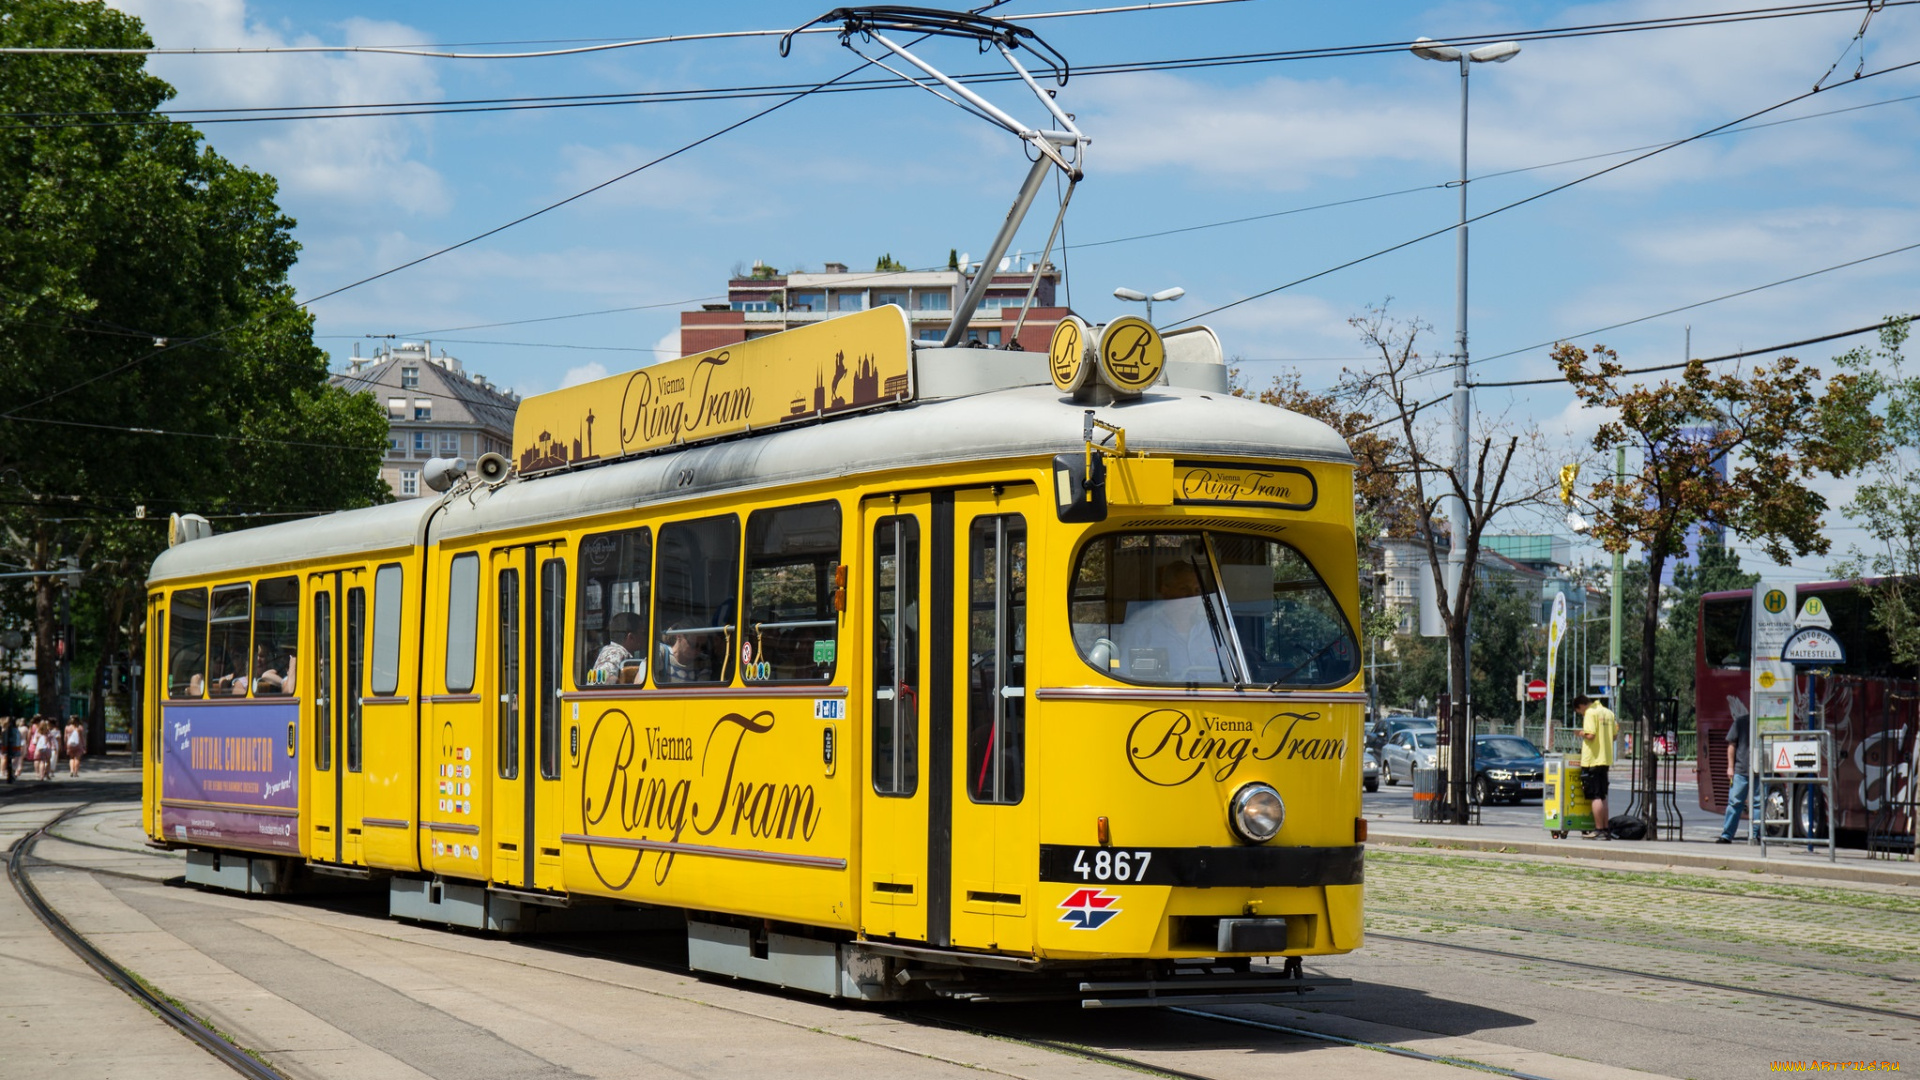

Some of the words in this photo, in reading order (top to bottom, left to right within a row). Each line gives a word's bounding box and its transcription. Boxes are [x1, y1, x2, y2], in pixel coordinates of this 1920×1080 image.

[1105, 324, 1158, 385] R
[657, 376, 685, 397] Vienna
[620, 370, 684, 456] Ring
[684, 351, 755, 432] Tram
[1182, 469, 1240, 500] Ring
[1240, 472, 1291, 499] Tram
[1217, 473, 1240, 482] Vienna
[1769, 594, 1782, 610] H
[1809, 601, 1818, 612] H
[1797, 631, 1831, 645] AUTOBUS
[1790, 650, 1836, 658] HALTESTELLE
[1203, 717, 1253, 731] Vienna
[191, 737, 223, 770] VIRTUAL
[225, 737, 272, 772] CONDUCTOR
[645, 727, 693, 761] Vienna
[1126, 708, 1252, 787] Ring
[1252, 711, 1348, 761] Tram
[582, 708, 691, 891] Ring
[692, 710, 821, 842] Tram
[1073, 850, 1152, 881] 4867
